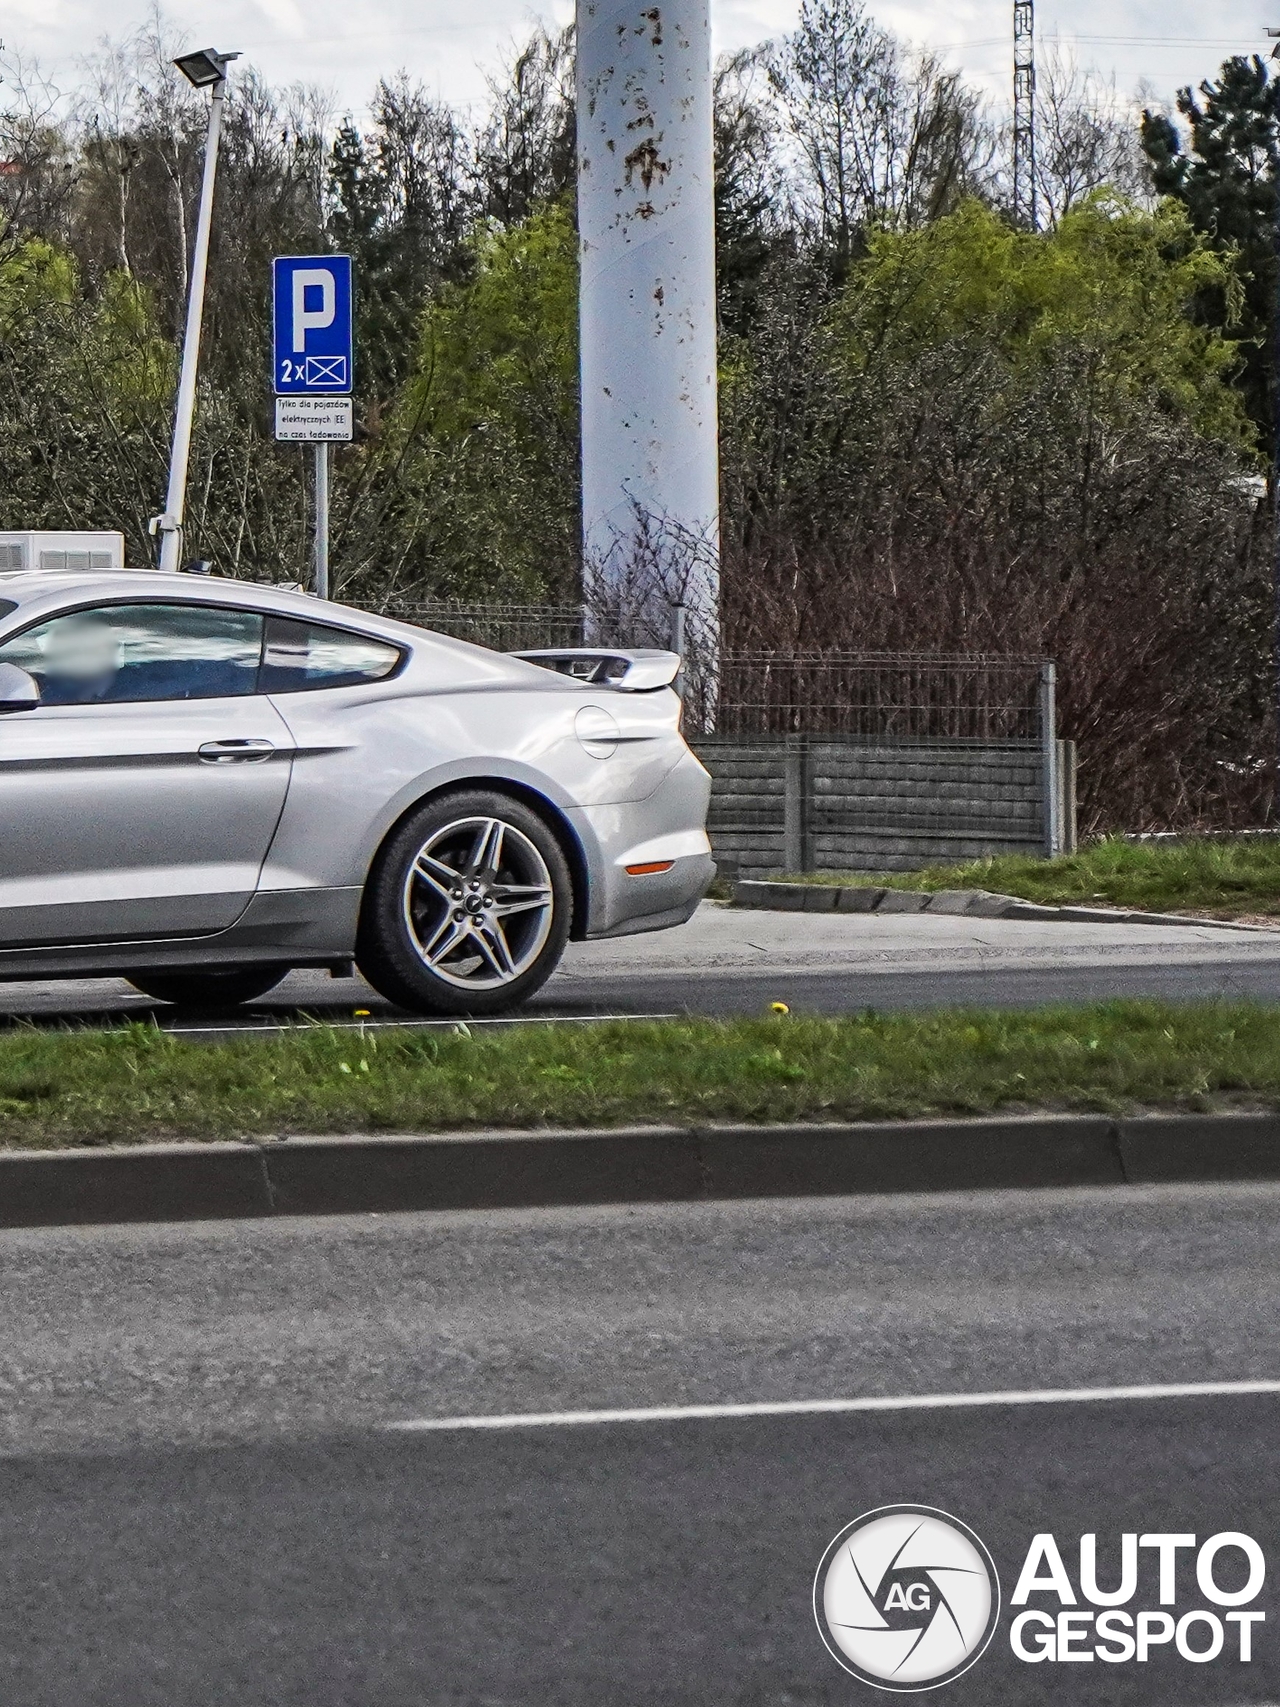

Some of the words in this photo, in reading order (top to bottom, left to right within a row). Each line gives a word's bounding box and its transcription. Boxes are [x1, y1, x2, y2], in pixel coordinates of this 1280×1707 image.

[292, 269, 335, 352] P
[281, 359, 305, 382] 2x
[278, 399, 296, 409] Tylko
[299, 400, 311, 408] dla
[314, 400, 349, 409] pojazdów
[282, 415, 331, 424] elektrycznych
[309, 430, 349, 438] ładowania
